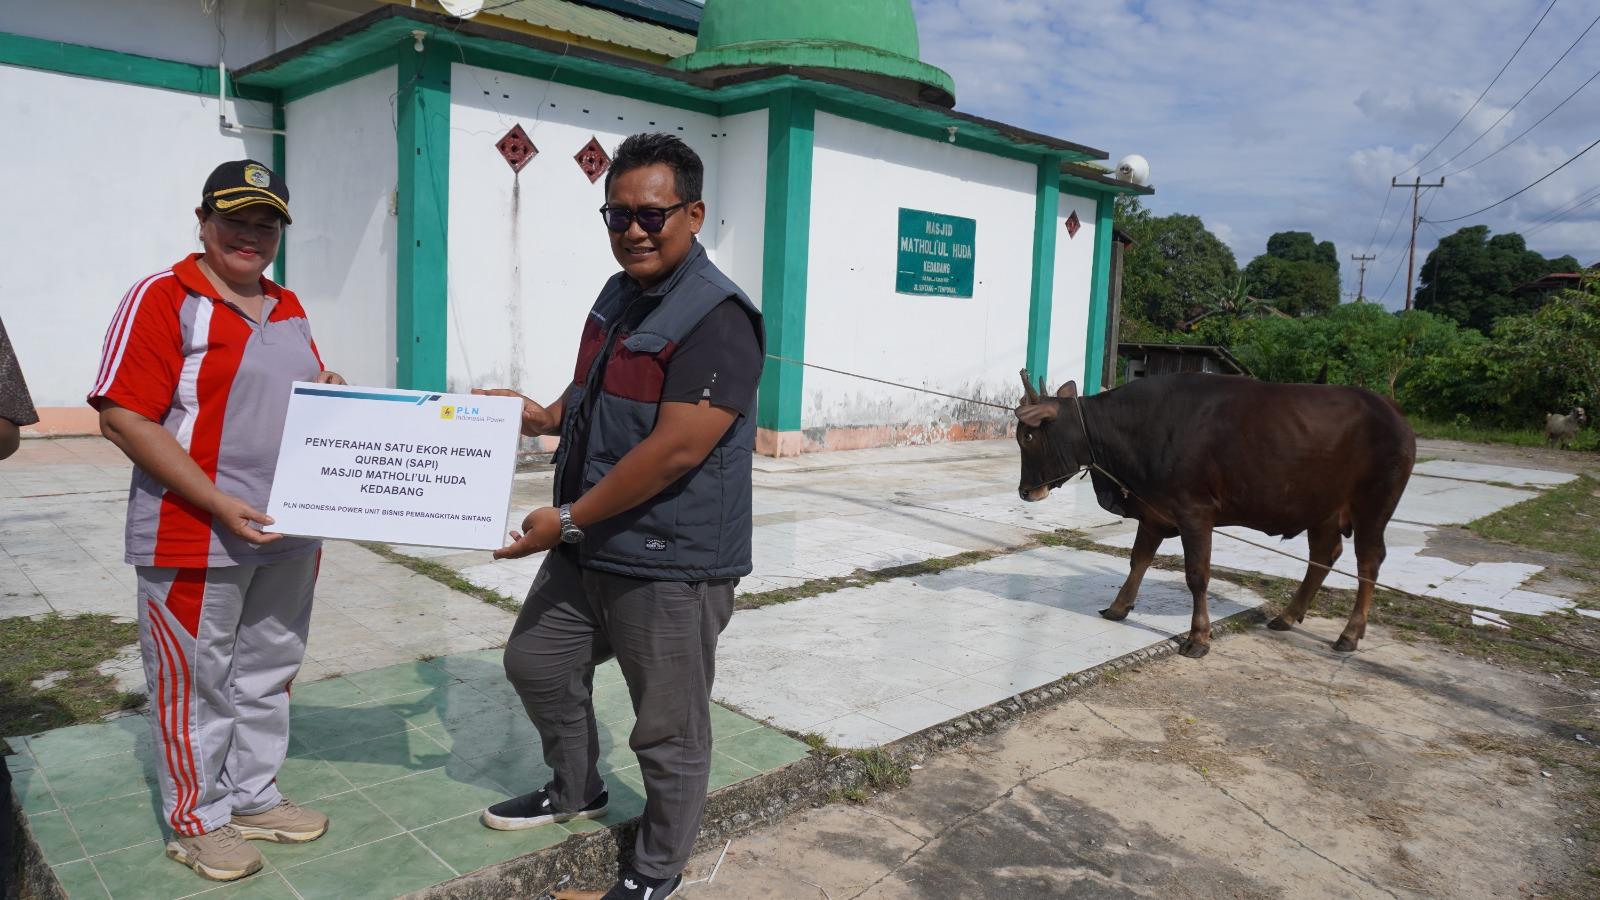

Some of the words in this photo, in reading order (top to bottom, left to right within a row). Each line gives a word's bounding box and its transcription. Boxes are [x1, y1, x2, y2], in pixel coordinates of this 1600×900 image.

[926, 220, 953, 237] MASJID
[952, 243, 972, 259] HUDA
[456, 406, 479, 415] PLN
[305, 437, 382, 451] PENYERAHAN
[384, 442, 413, 453] SATU
[416, 444, 448, 456] EKOR
[450, 446, 492, 458] HEWAN
[355, 455, 403, 467] QURBAN
[405, 458, 439, 471] (SAPI)
[320, 466, 363, 478] MASJID
[365, 470, 432, 483] MATHOLI'UL
[435, 474, 467, 486] HUDA
[360, 484, 424, 497] KEDABANG
[282, 501, 297, 509] PLN
[298, 503, 336, 512] INDONESIA
[337, 505, 363, 514] POWER
[381, 509, 404, 517] BISNIS
[405, 510, 460, 520] PEMBANGKITAN
[461, 514, 492, 522] SINTANG
